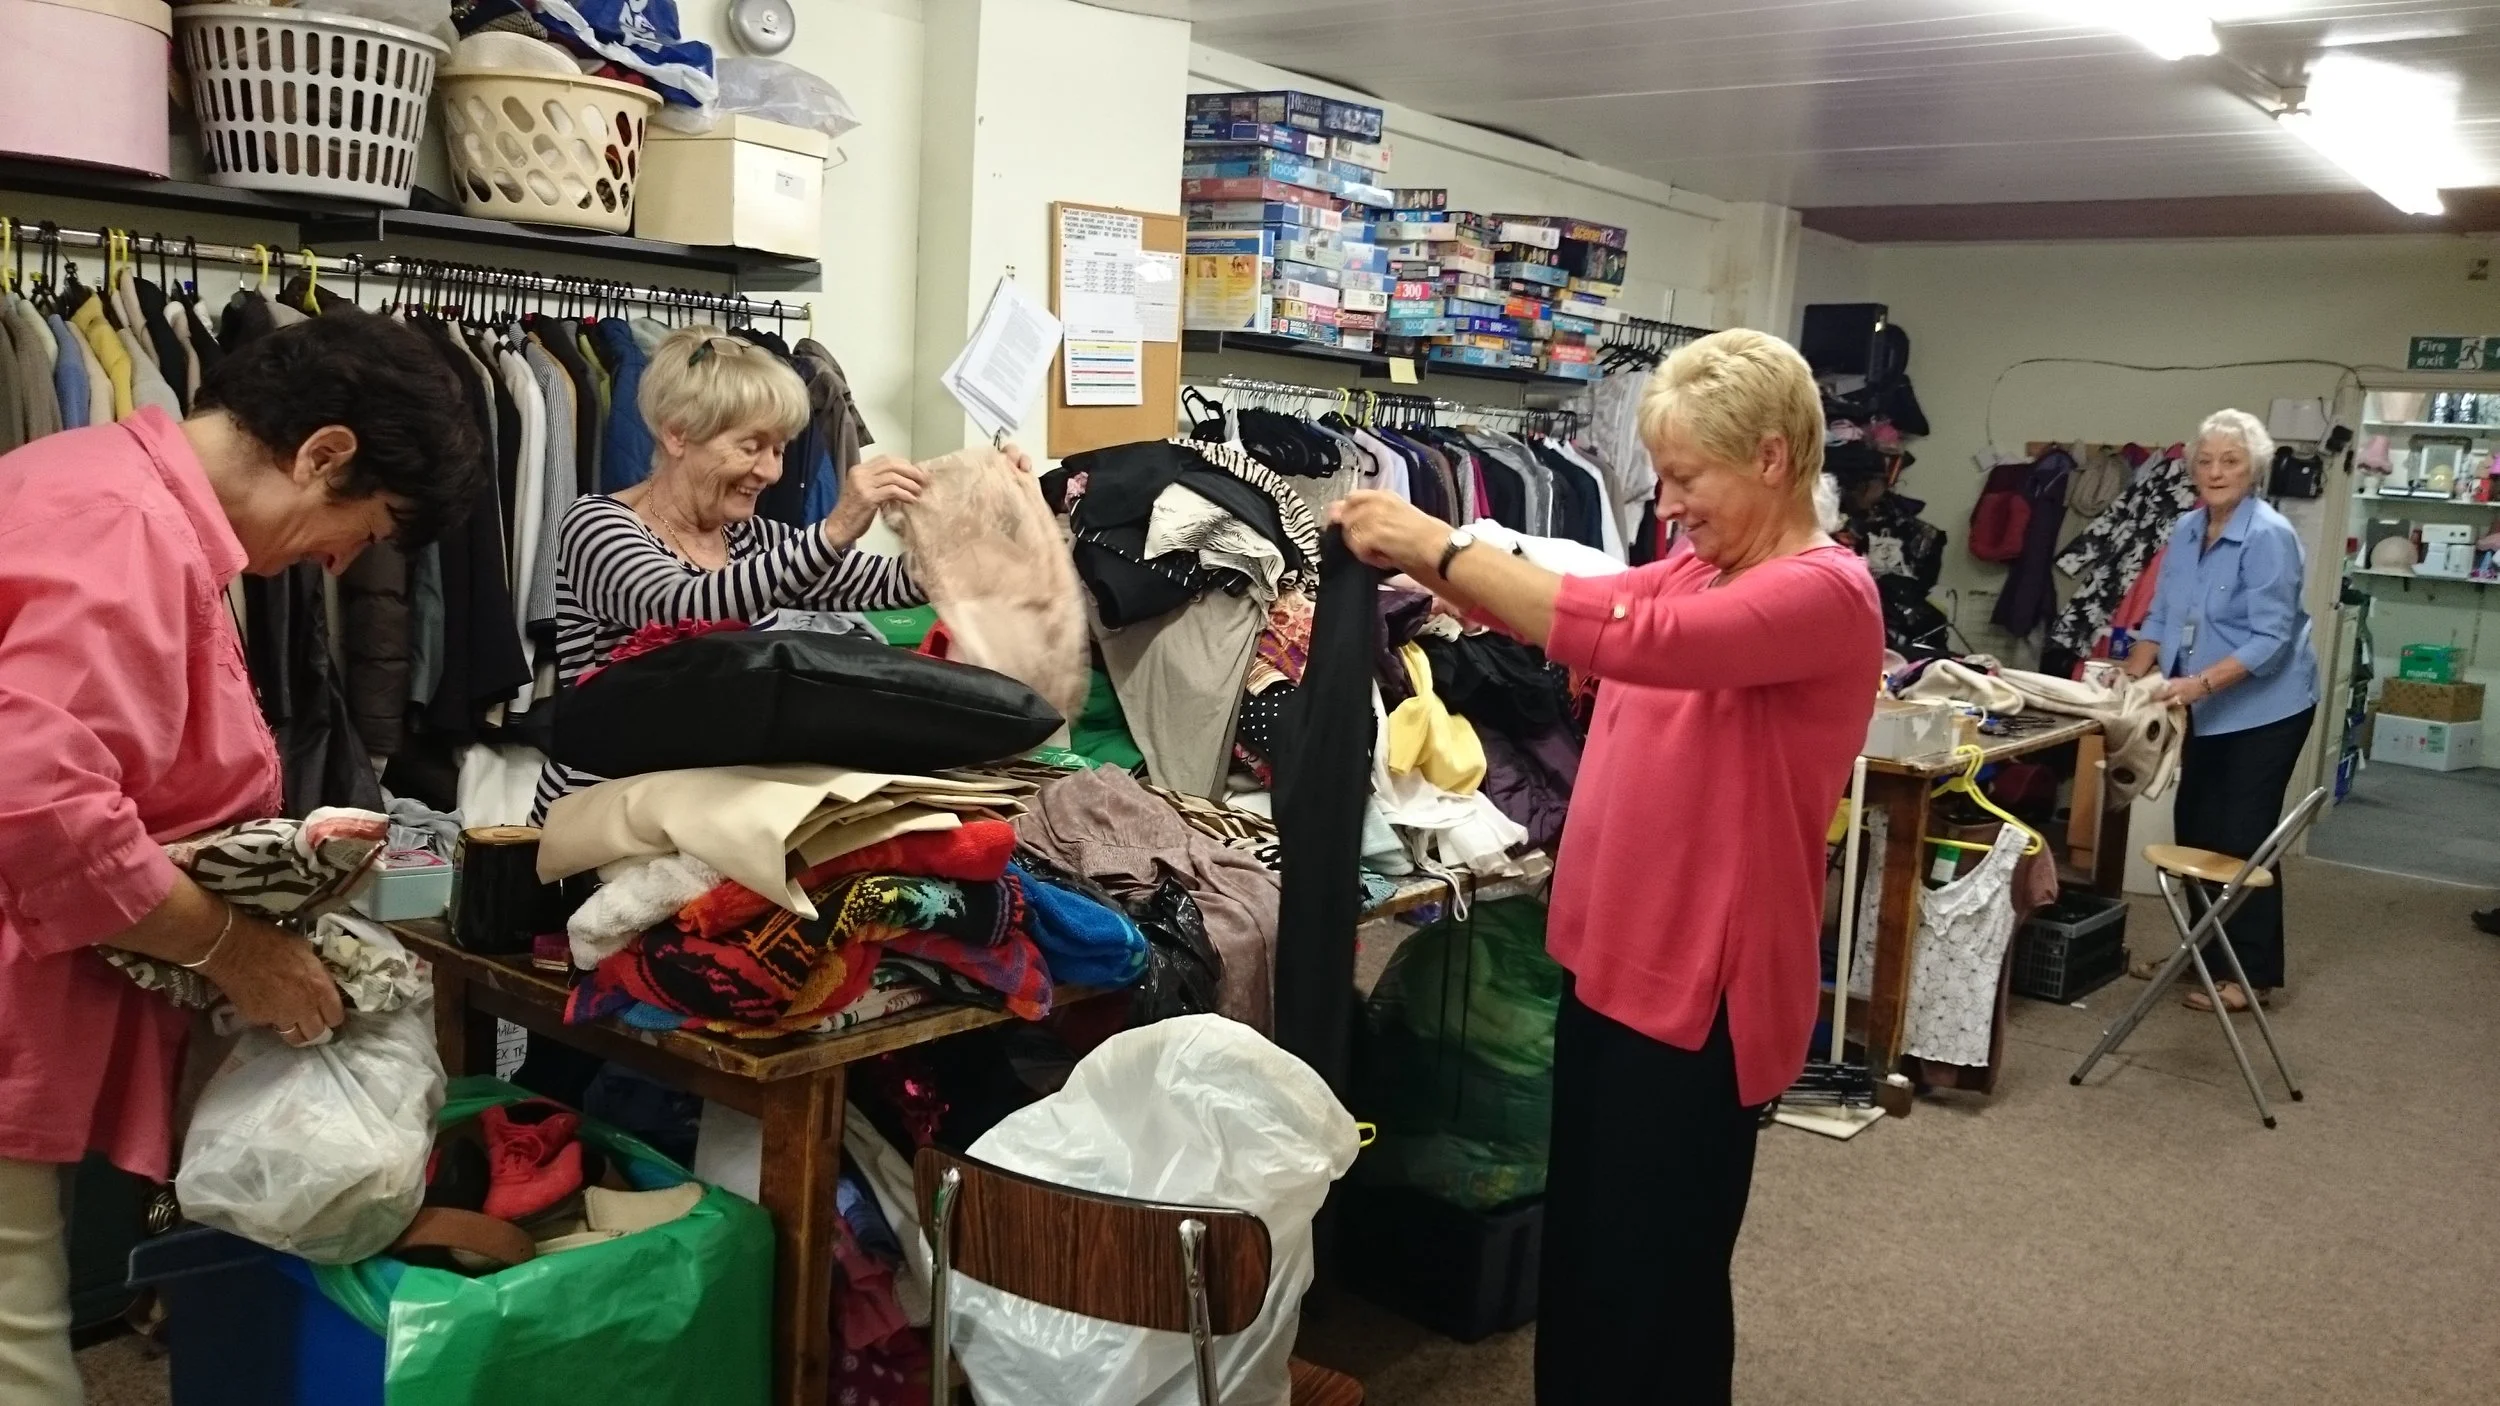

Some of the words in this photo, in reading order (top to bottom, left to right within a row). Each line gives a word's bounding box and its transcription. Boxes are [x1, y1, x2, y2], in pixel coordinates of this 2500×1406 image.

[1273, 163, 1297, 177] 1000
[1402, 283, 1422, 298] 300
[2418, 340, 2447, 353] Fire
[2416, 354, 2445, 368] exit
